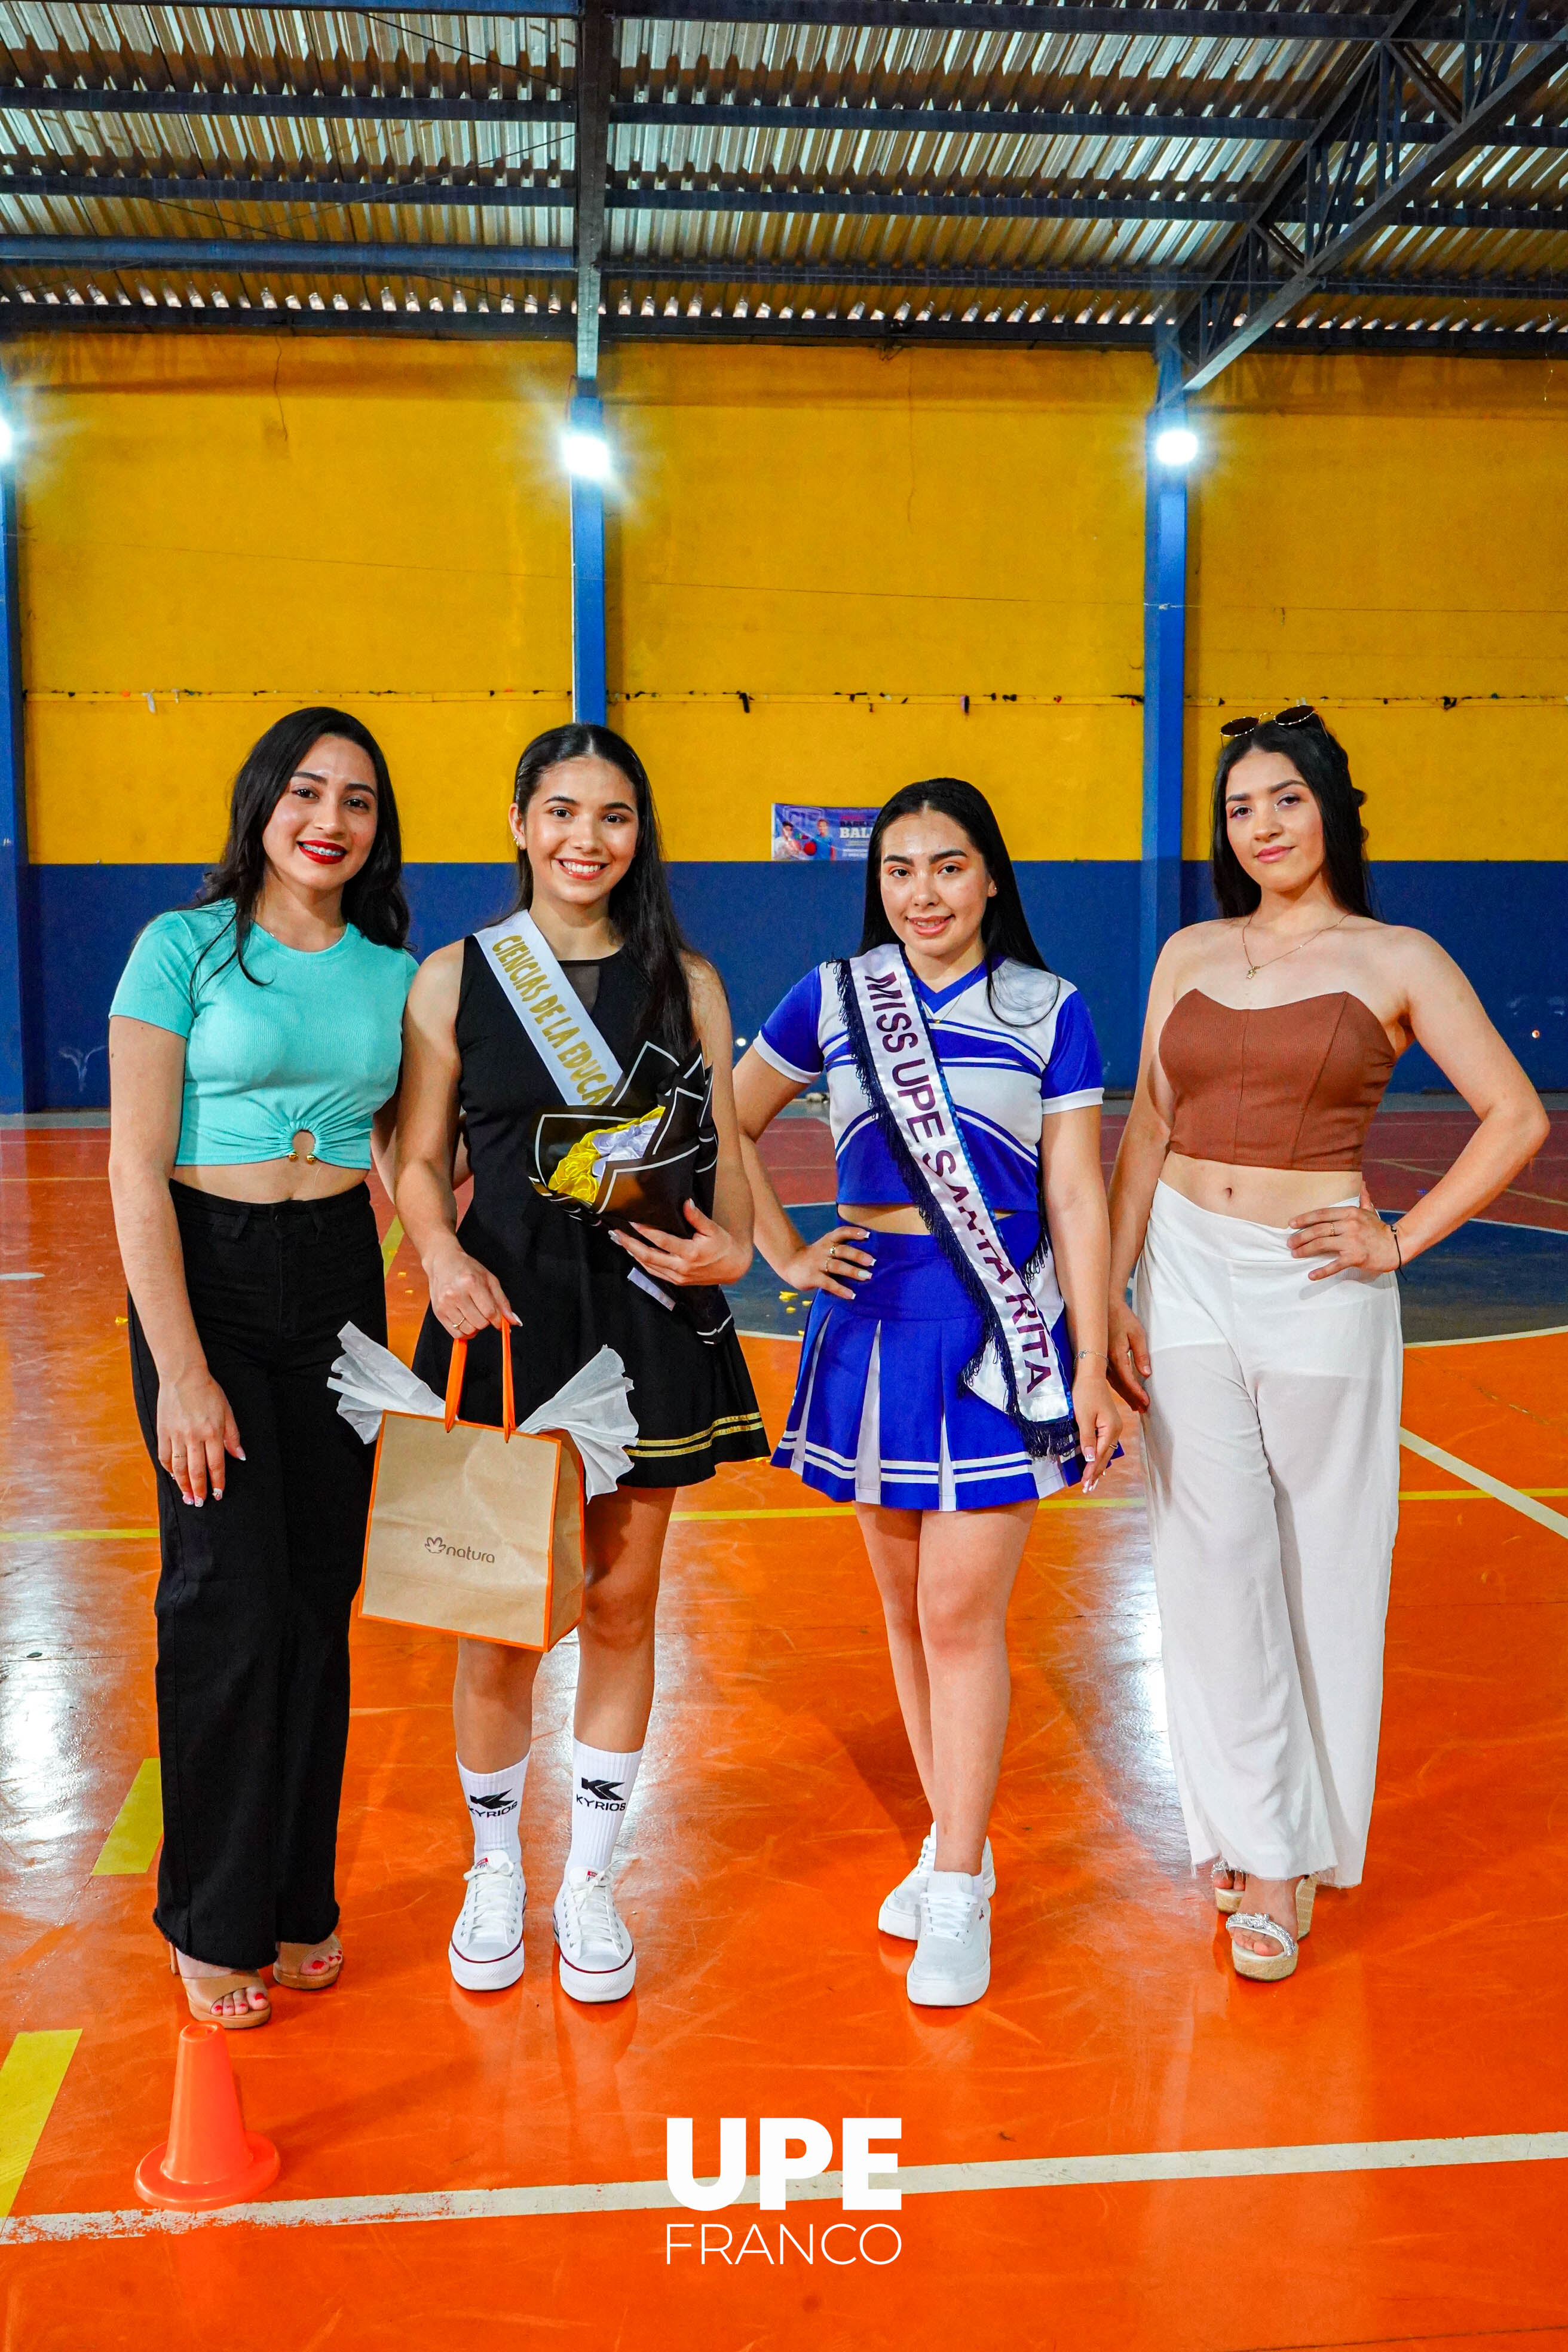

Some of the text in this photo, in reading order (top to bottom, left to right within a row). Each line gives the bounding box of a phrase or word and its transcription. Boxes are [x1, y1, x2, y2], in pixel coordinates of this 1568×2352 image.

[492, 935, 614, 1105] CIENCIAS DE LA EDUCA
[865, 971, 918, 1053] MISS
[892, 1058, 945, 1143] UPE
[1005, 1293, 1052, 1394] RITA
[446, 1546, 495, 1563] natura
[468, 1800, 517, 1818] KYRIOS
[577, 1793, 626, 1811] KYRIOS
